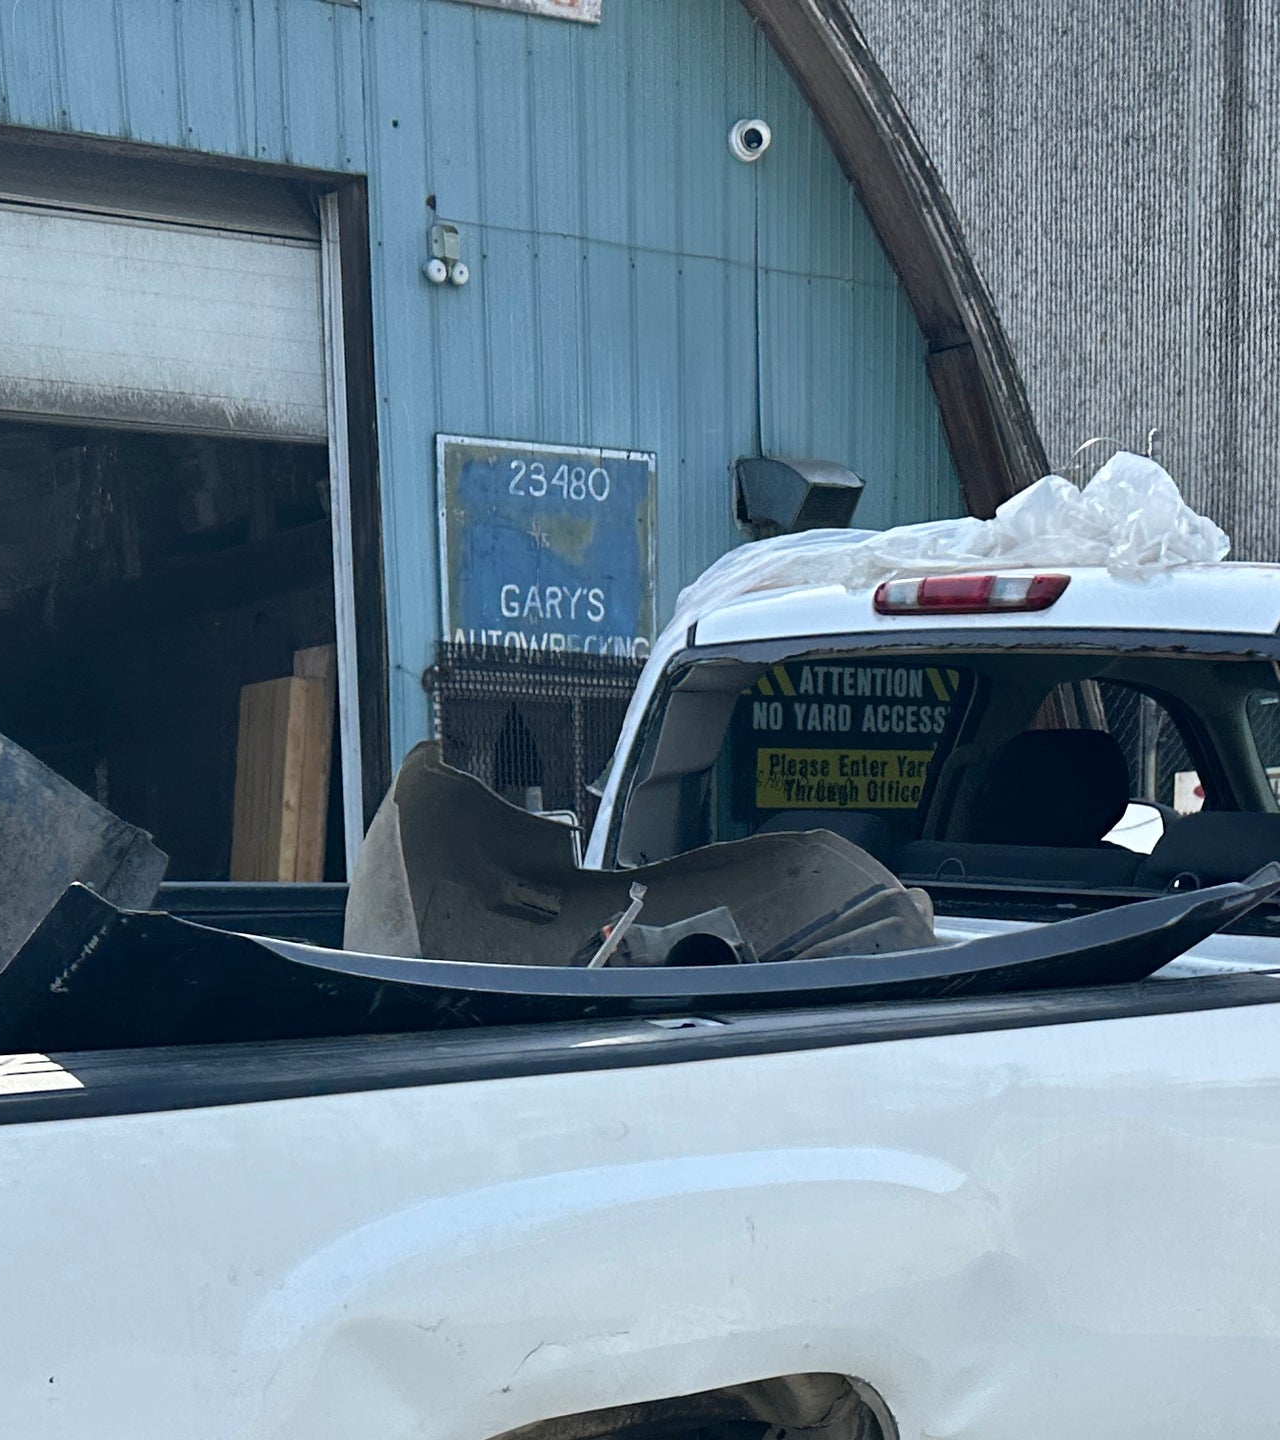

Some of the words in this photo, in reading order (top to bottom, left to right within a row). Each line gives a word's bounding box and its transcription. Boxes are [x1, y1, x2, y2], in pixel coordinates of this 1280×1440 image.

[508, 459, 611, 502] 23480
[500, 583, 605, 622] GARY'S
[799, 665, 924, 698] ATTENTION
[752, 701, 784, 731] NO
[793, 703, 852, 732] YARD
[769, 753, 829, 777] Please
[839, 755, 888, 777] Enter
[897, 755, 930, 777] Yar
[785, 778, 859, 806] Through
[867, 780, 922, 803] Office
